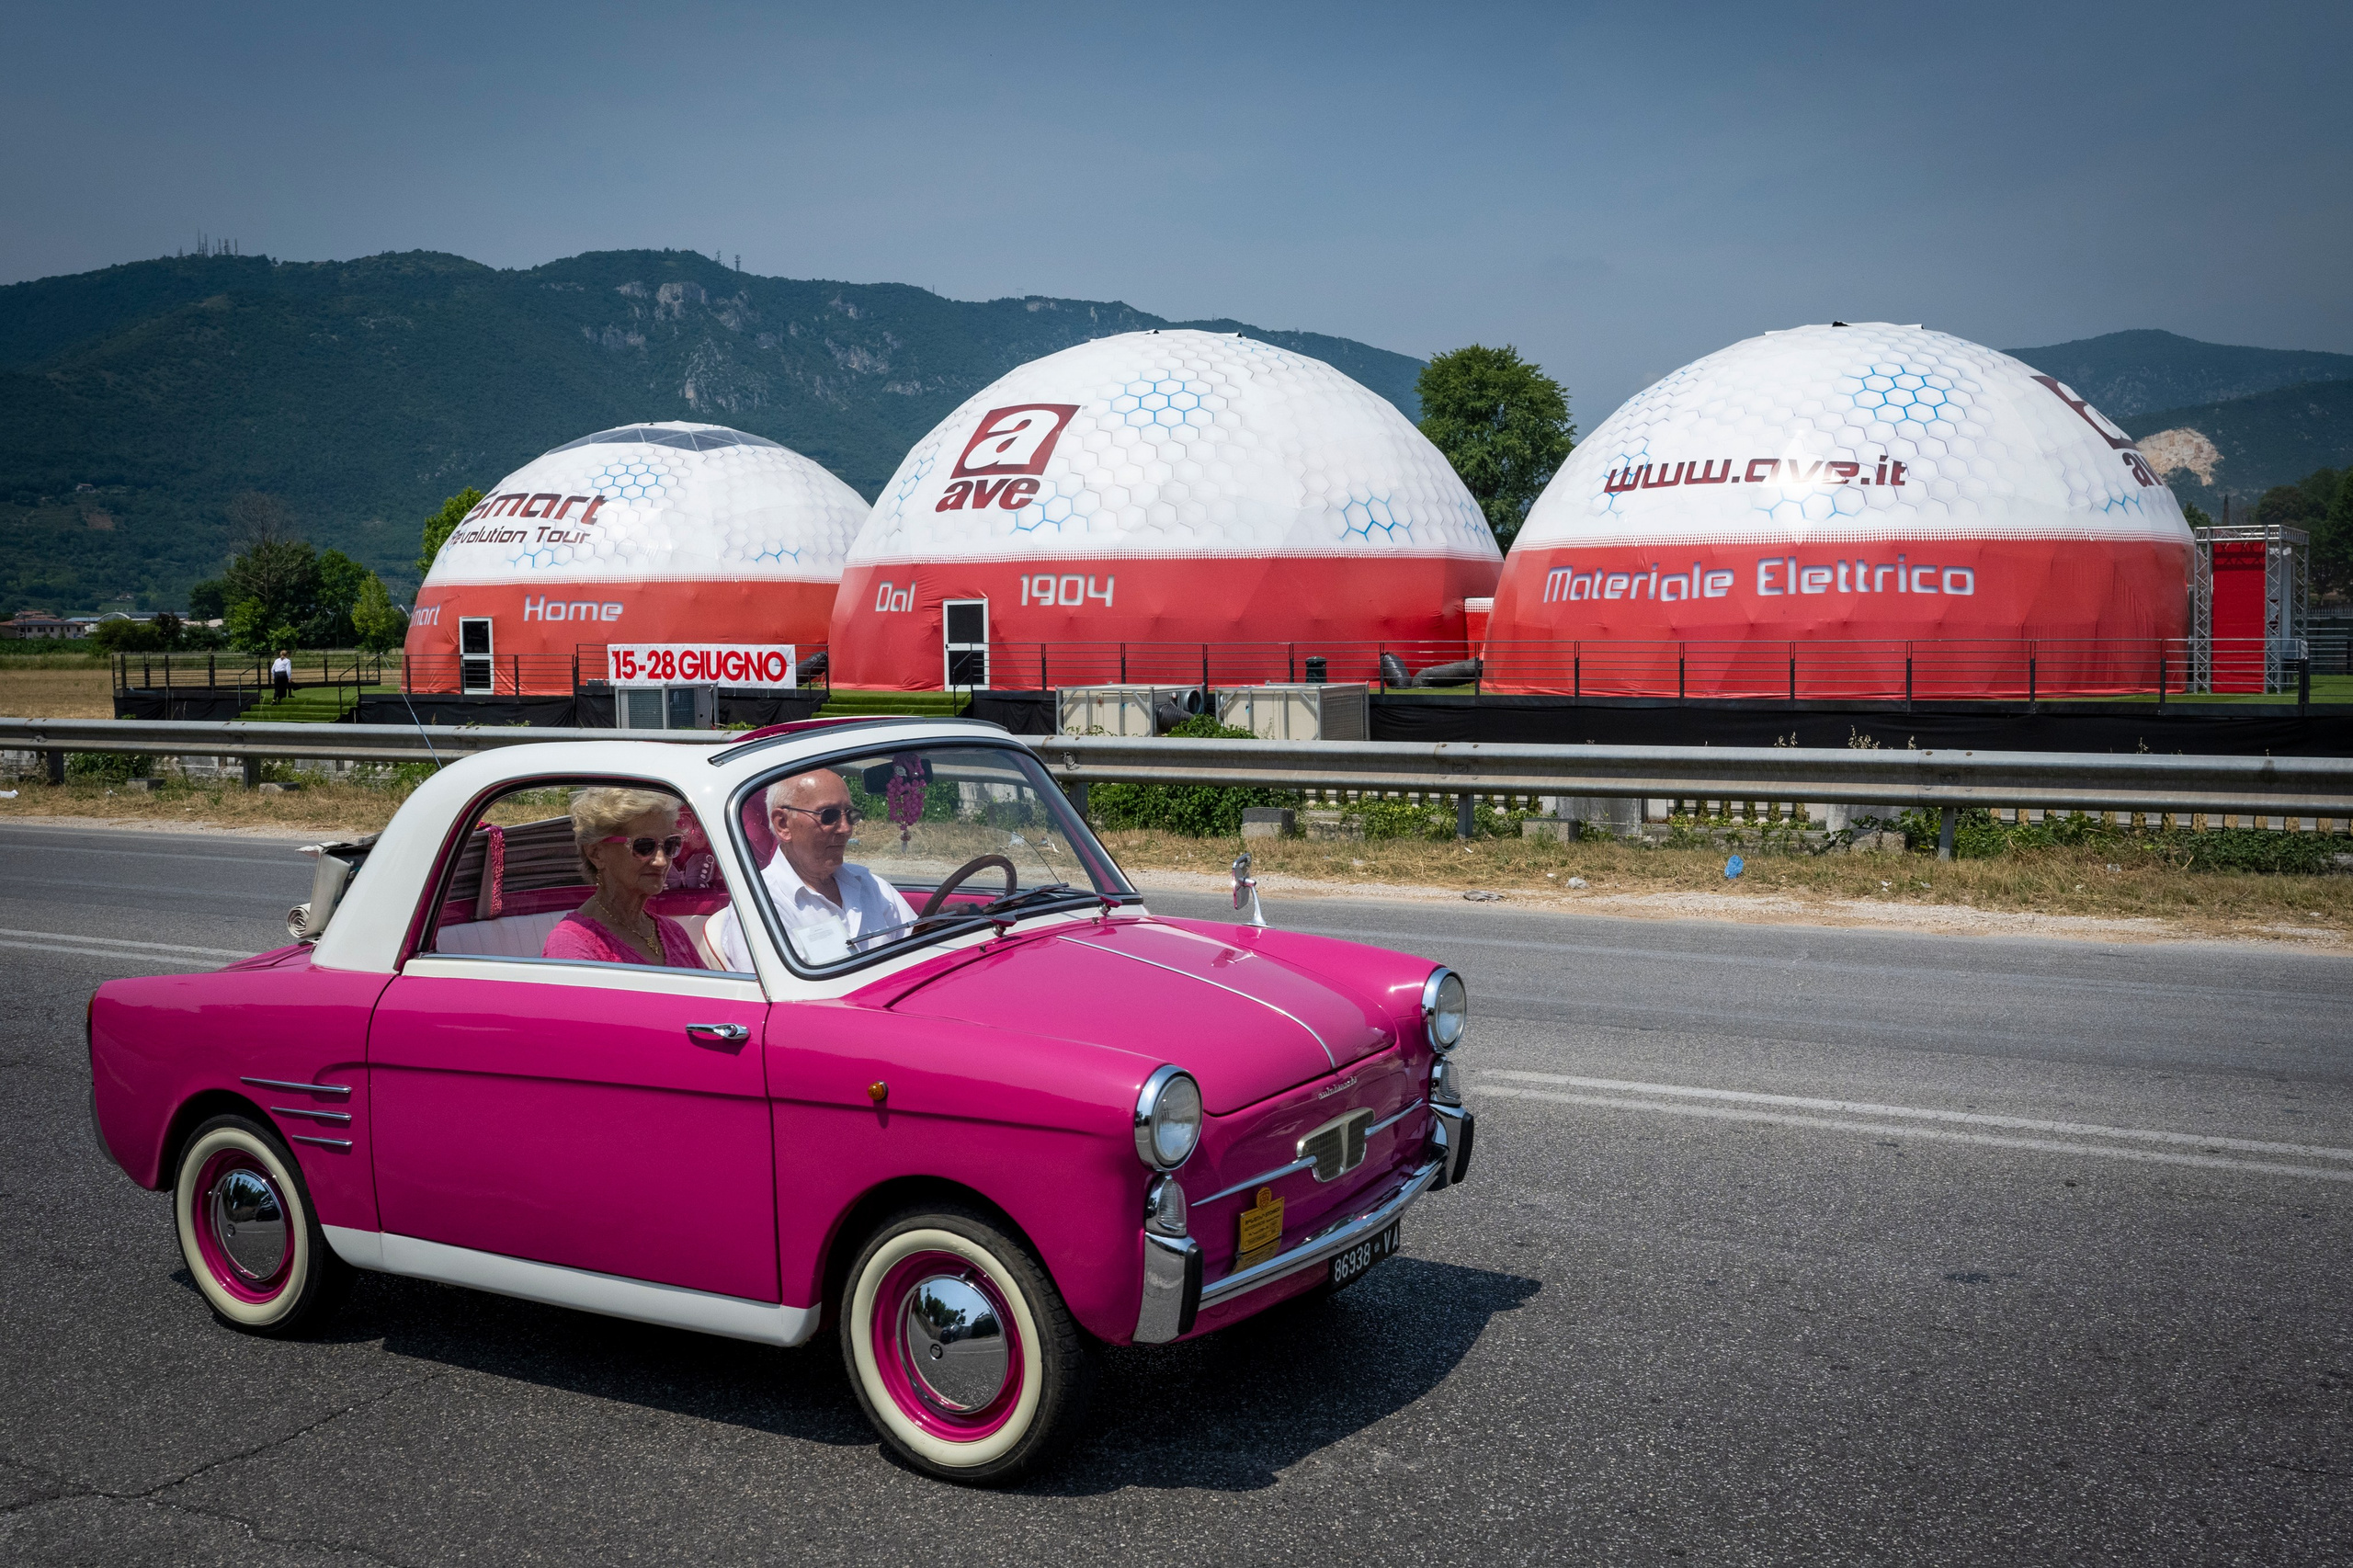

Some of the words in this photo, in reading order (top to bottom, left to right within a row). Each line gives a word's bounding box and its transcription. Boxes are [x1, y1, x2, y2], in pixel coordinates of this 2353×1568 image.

[1604, 455, 1907, 494] www.ave.it
[461, 490, 608, 527] Smart
[935, 477, 1040, 513] ave
[536, 526, 591, 544] Tour
[875, 581, 916, 612] Dal
[1020, 574, 1115, 608] 1904
[1543, 562, 1734, 603] Materiale
[1757, 553, 1975, 597] Elettrico
[524, 594, 624, 622] Home
[612, 650, 676, 680] 15-28
[678, 650, 788, 683] GIUGNO
[1335, 1242, 1371, 1282] 86938
